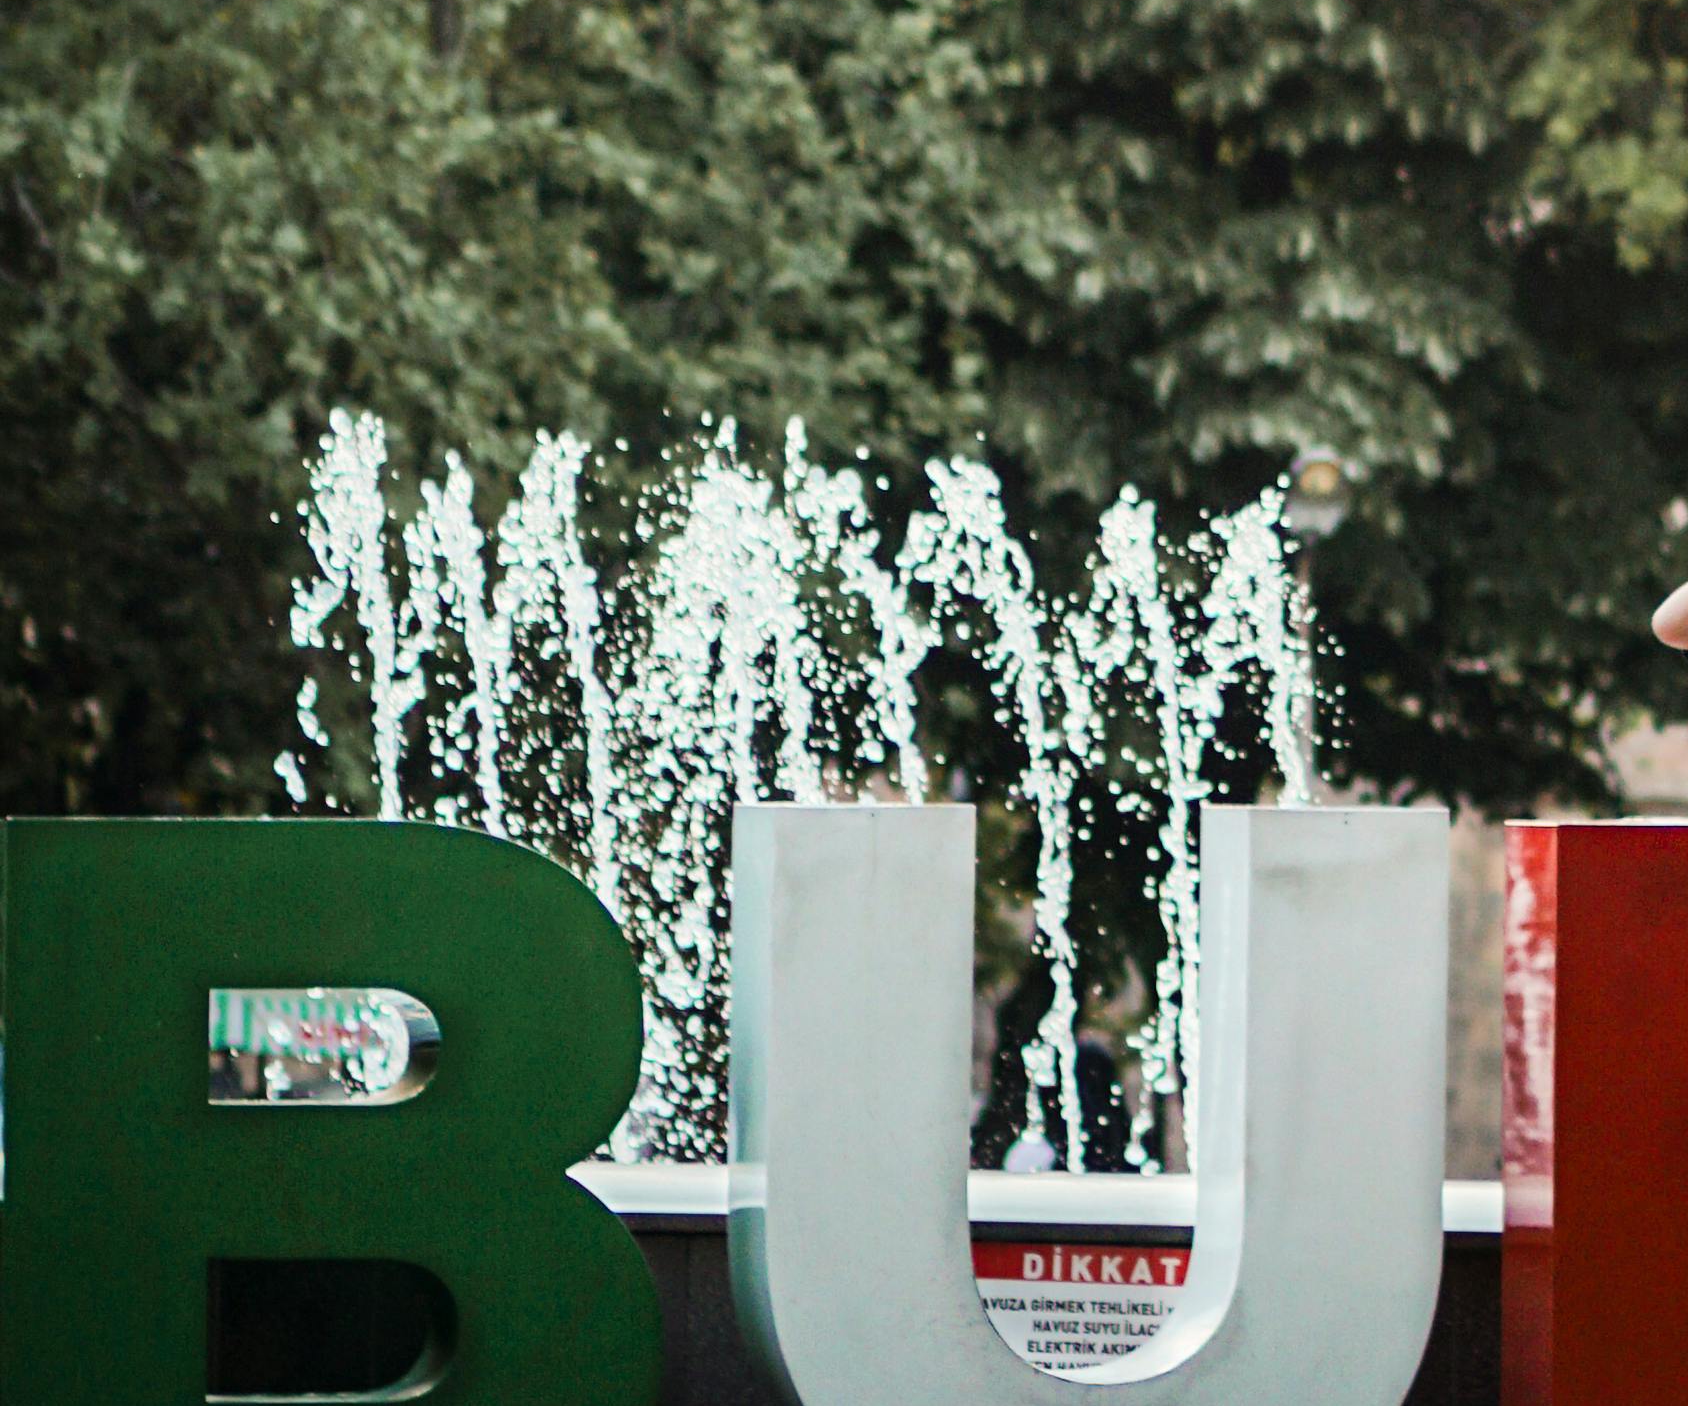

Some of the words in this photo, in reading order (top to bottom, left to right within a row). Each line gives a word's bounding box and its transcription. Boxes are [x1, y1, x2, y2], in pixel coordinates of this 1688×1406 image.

[1022, 1246, 1182, 1285] DİKKAT
[1031, 1296, 1085, 1313] GİRMEK
[1090, 1298, 1163, 1316] TEHLİKELİ
[1033, 1320, 1079, 1334] HAVUZ
[1083, 1321, 1120, 1335] SUYU
[1027, 1338, 1096, 1354] ELEKTRİK
